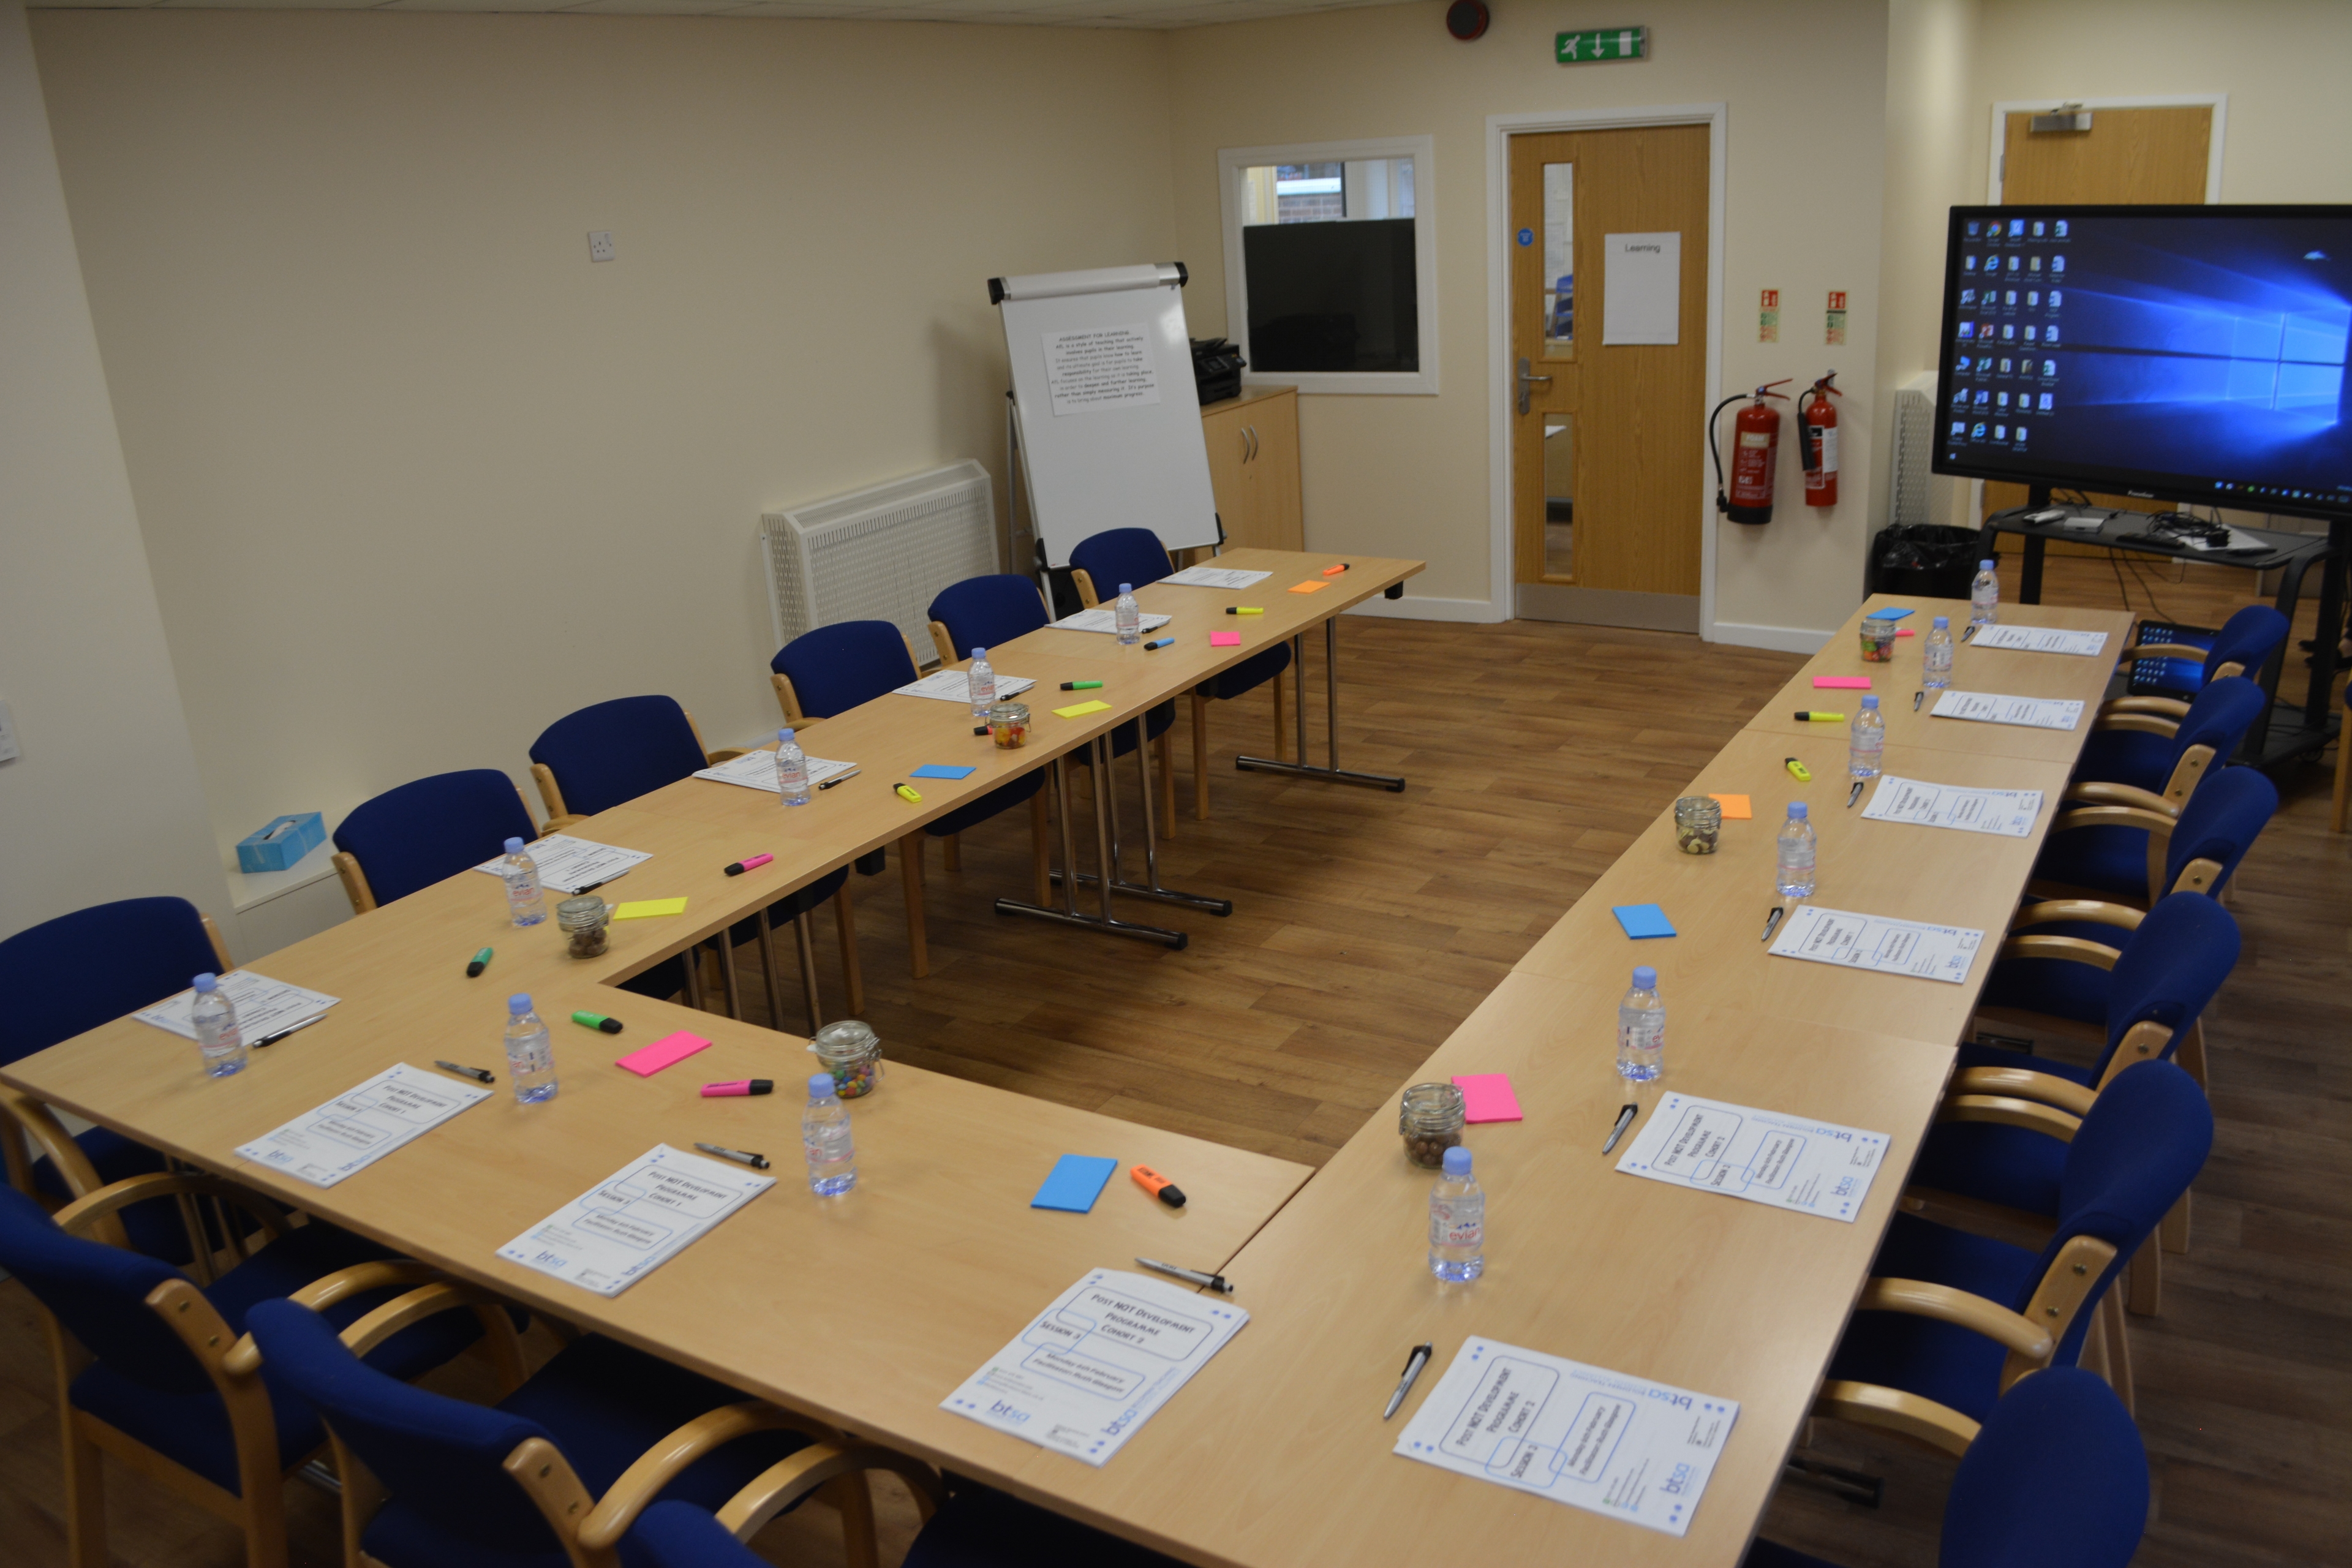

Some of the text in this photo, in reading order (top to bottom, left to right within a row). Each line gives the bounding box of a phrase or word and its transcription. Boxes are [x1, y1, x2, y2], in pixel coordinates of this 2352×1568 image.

[1625, 244, 1661, 254] Learning
[513, 888, 535, 896] evian
[1816, 1128, 1852, 1142] btsa
[1831, 1177, 1853, 1196] btsa
[1449, 1227, 1480, 1240] evian
[535, 1251, 567, 1267] btsa
[1114, 1302, 1136, 1313] NQT
[1649, 1389, 1692, 1410] btsa
[990, 1400, 1030, 1422] btsa
[1101, 1409, 1137, 1436] btsa
[1660, 1463, 1690, 1494] btsa
